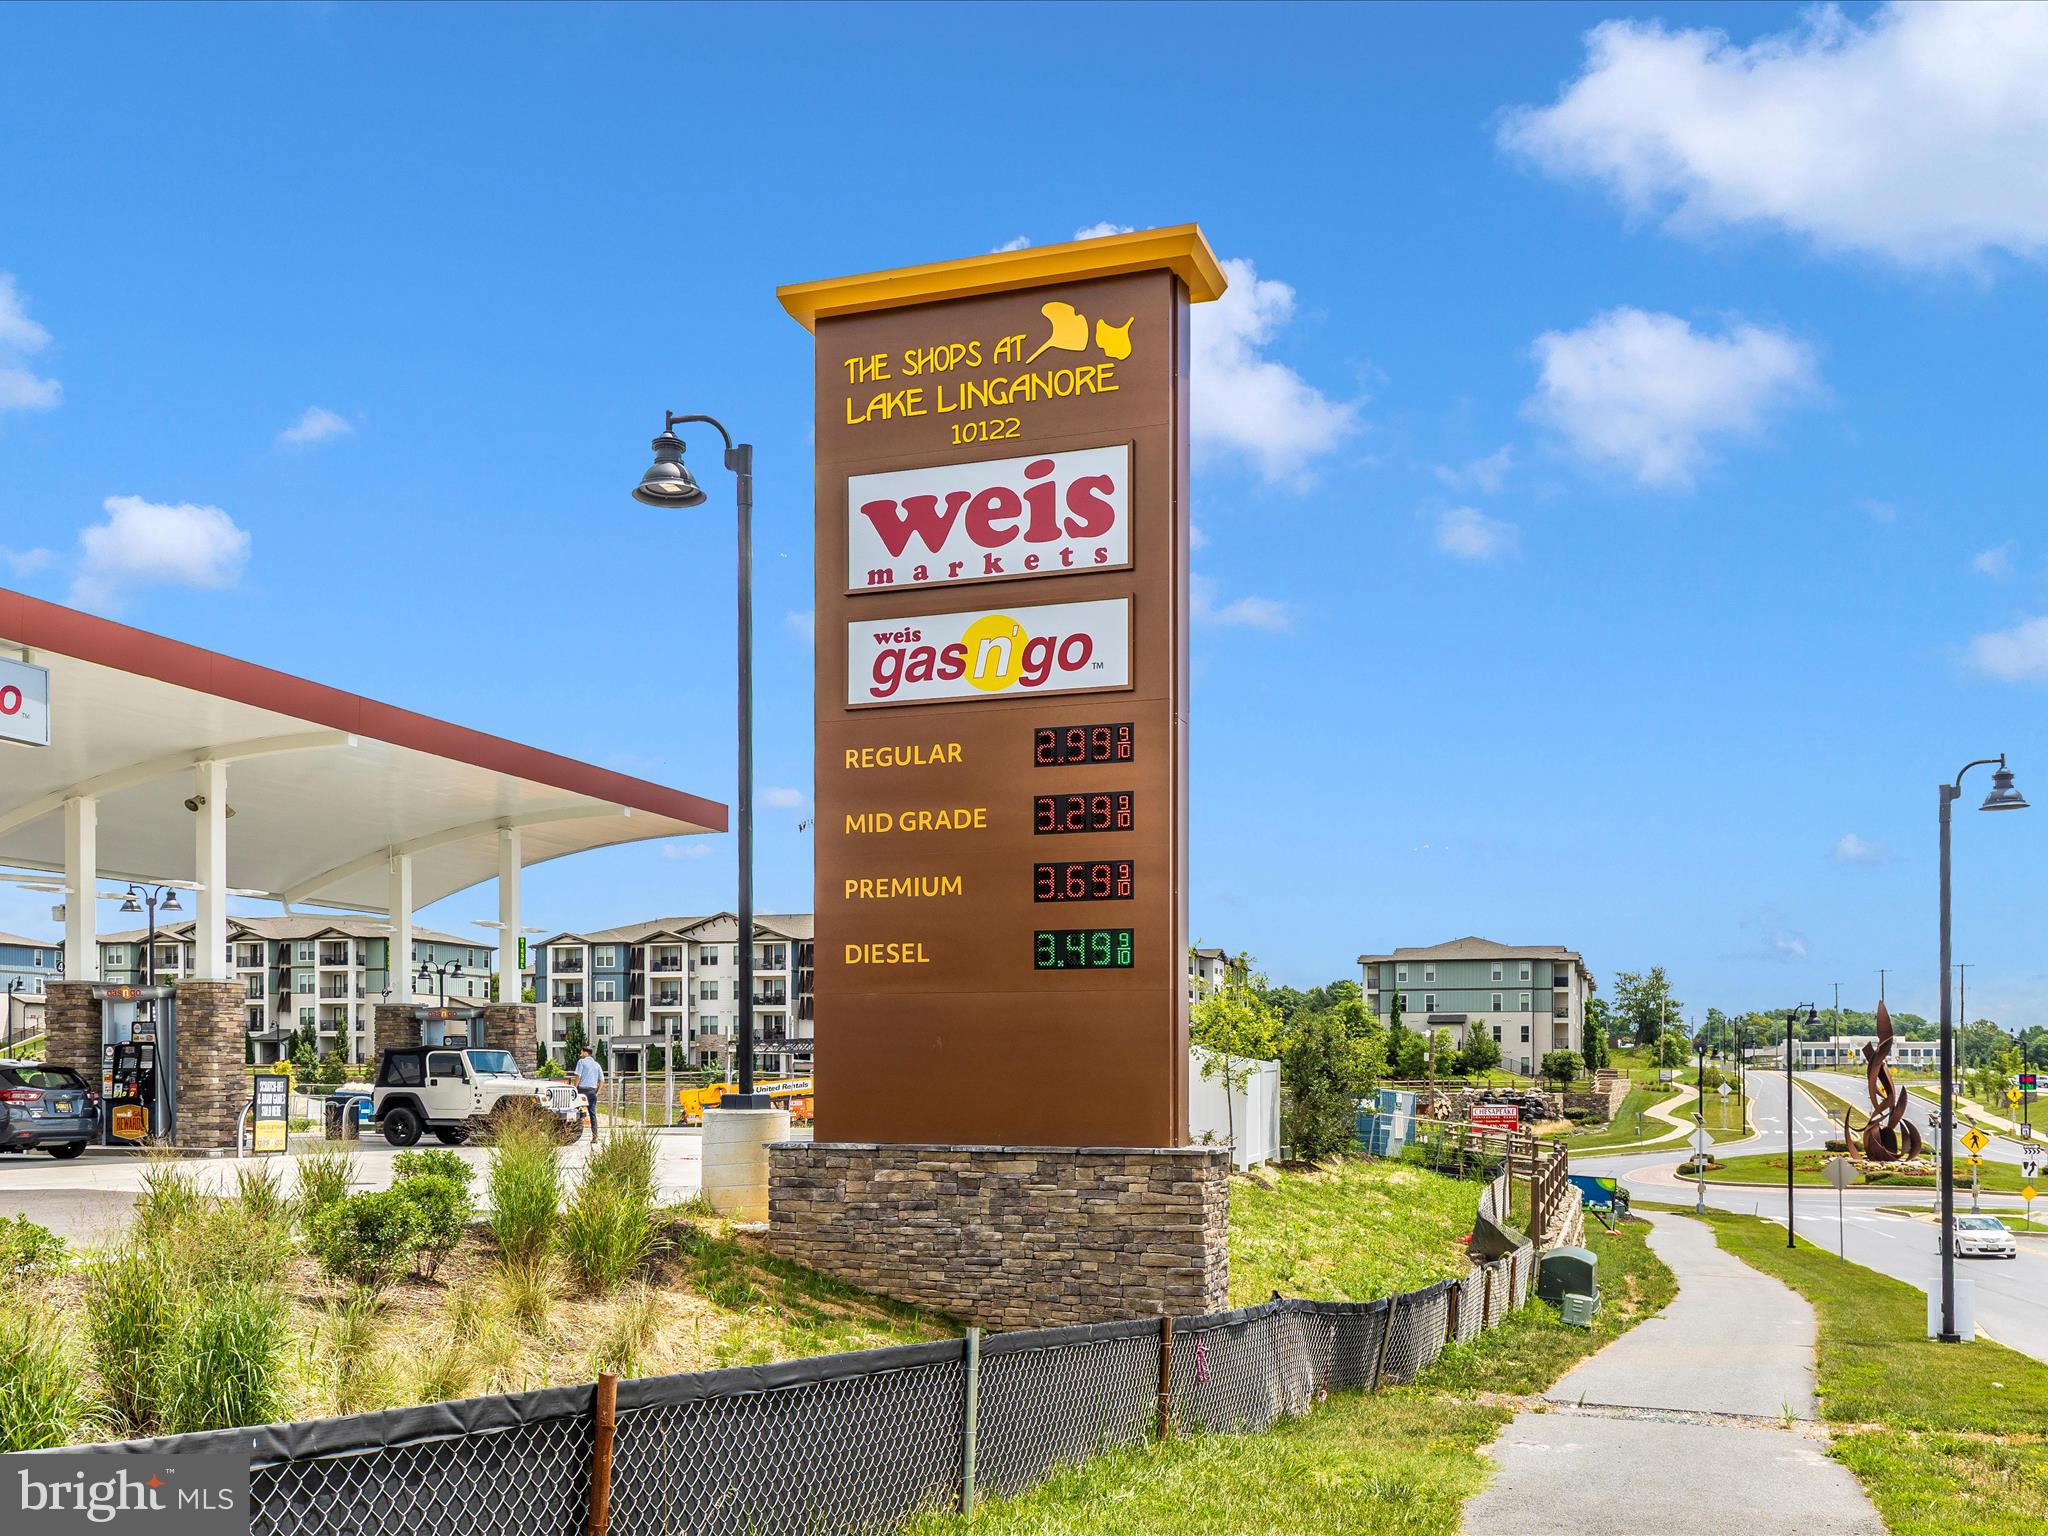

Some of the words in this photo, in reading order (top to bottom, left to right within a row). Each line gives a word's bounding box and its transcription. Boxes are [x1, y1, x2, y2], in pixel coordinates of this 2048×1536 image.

[844, 353, 892, 384] THE
[902, 340, 983, 376] SHOPS
[993, 334, 1027, 364] AT
[846, 388, 928, 425] LAKE
[937, 363, 1120, 414] LINGANORE
[951, 417, 1021, 445] 10122
[860, 458, 1116, 558] weis
[867, 546, 1109, 586] markets
[873, 626, 921, 645] weis
[845, 743, 963, 769] REGULAR
[1037, 728, 1111, 763] 2.99
[845, 813, 894, 834] MID
[899, 808, 987, 832] GRADE
[1038, 795, 1111, 831] 3.29
[845, 876, 963, 899] PREMIUM
[1038, 864, 1111, 899] 3.69
[845, 943, 930, 965] DIESEL
[1038, 932, 1111, 967] 3.49
[756, 1084, 780, 1093] United
[782, 1082, 808, 1090] Rentals
